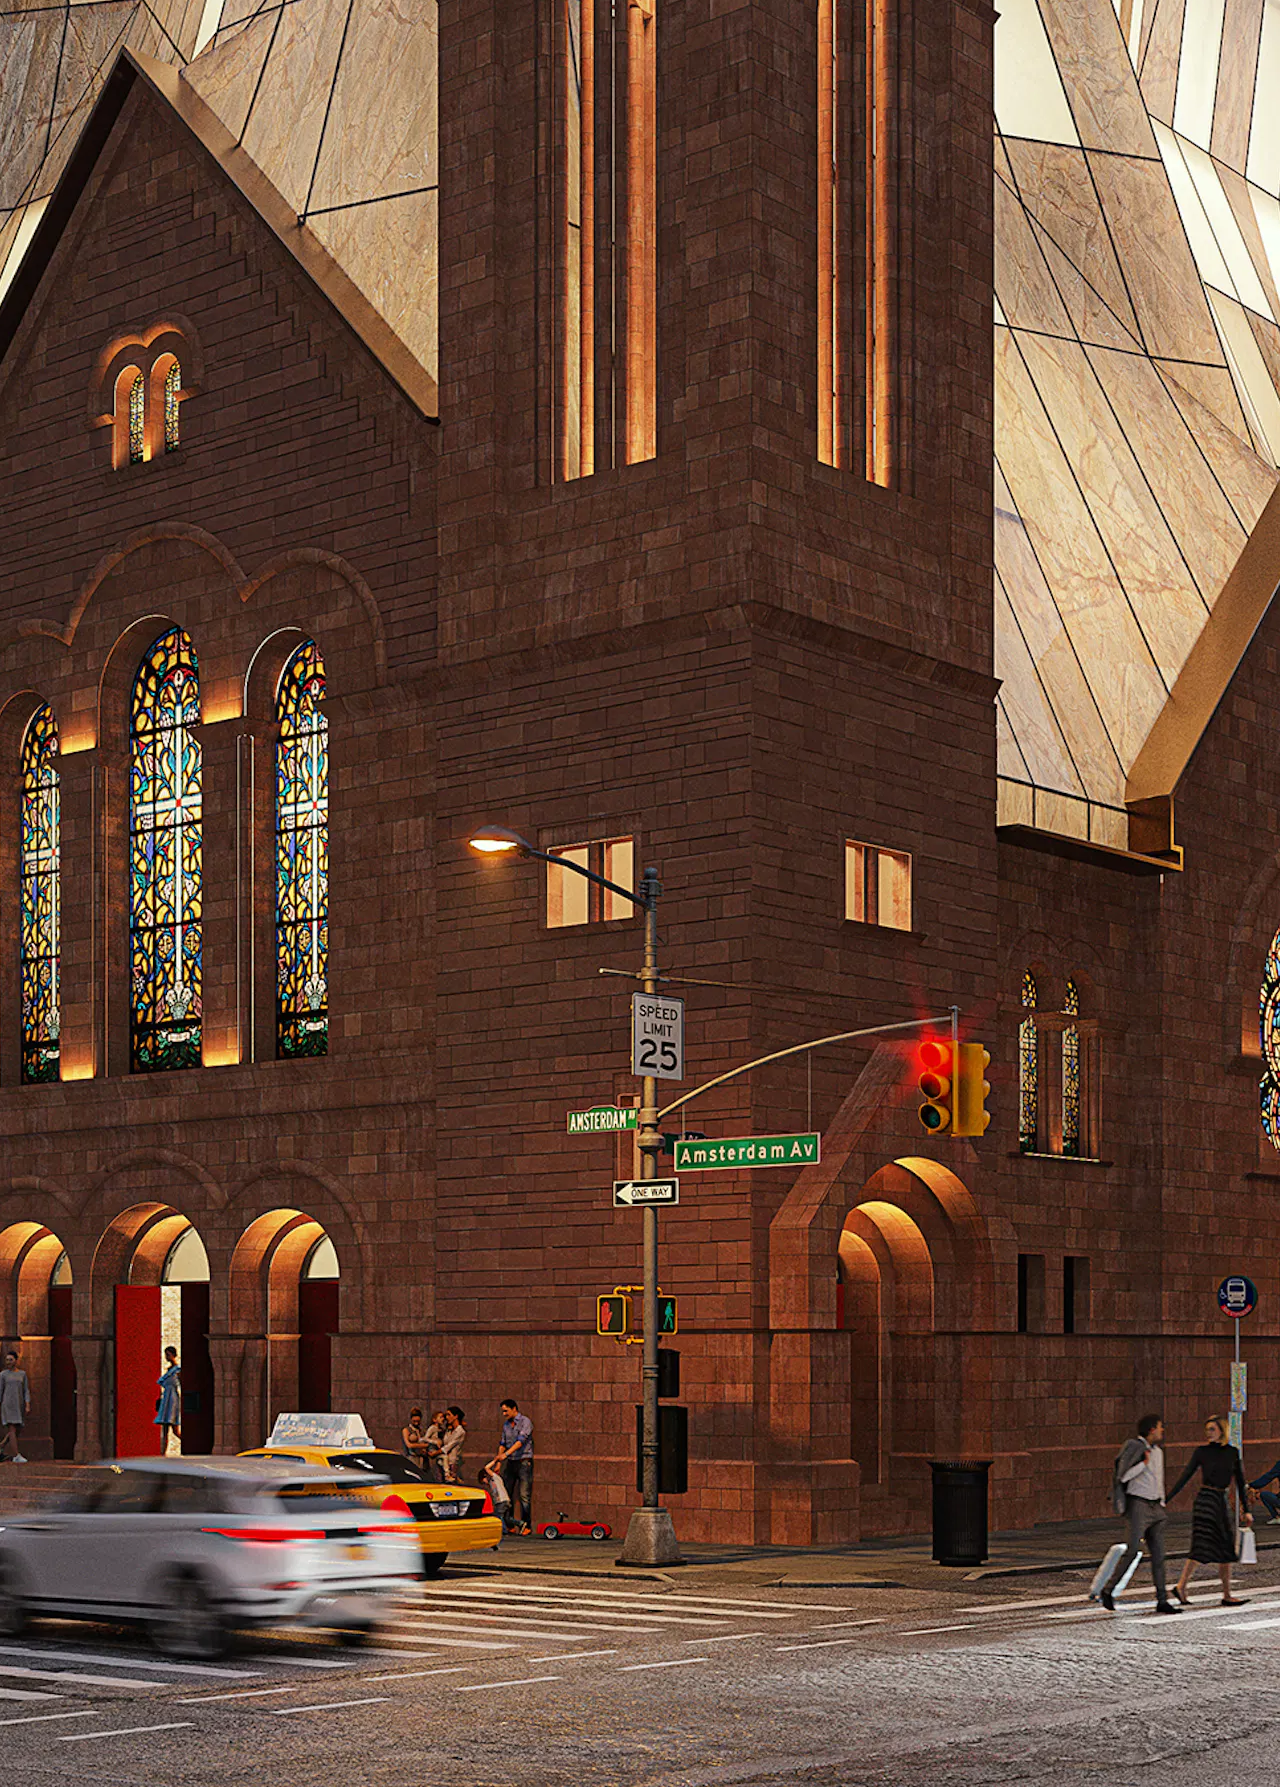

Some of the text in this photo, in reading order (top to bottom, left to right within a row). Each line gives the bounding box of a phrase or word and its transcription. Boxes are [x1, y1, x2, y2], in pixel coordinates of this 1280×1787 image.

[639, 1004, 678, 1021] SPEED
[643, 1021, 673, 1037] LIMIT
[639, 1038, 678, 1071] 25
[569, 1110, 627, 1131] AMSTERDAM
[680, 1141, 814, 1165] Amsterdam Av
[631, 1187, 669, 1198] ONE WAY
